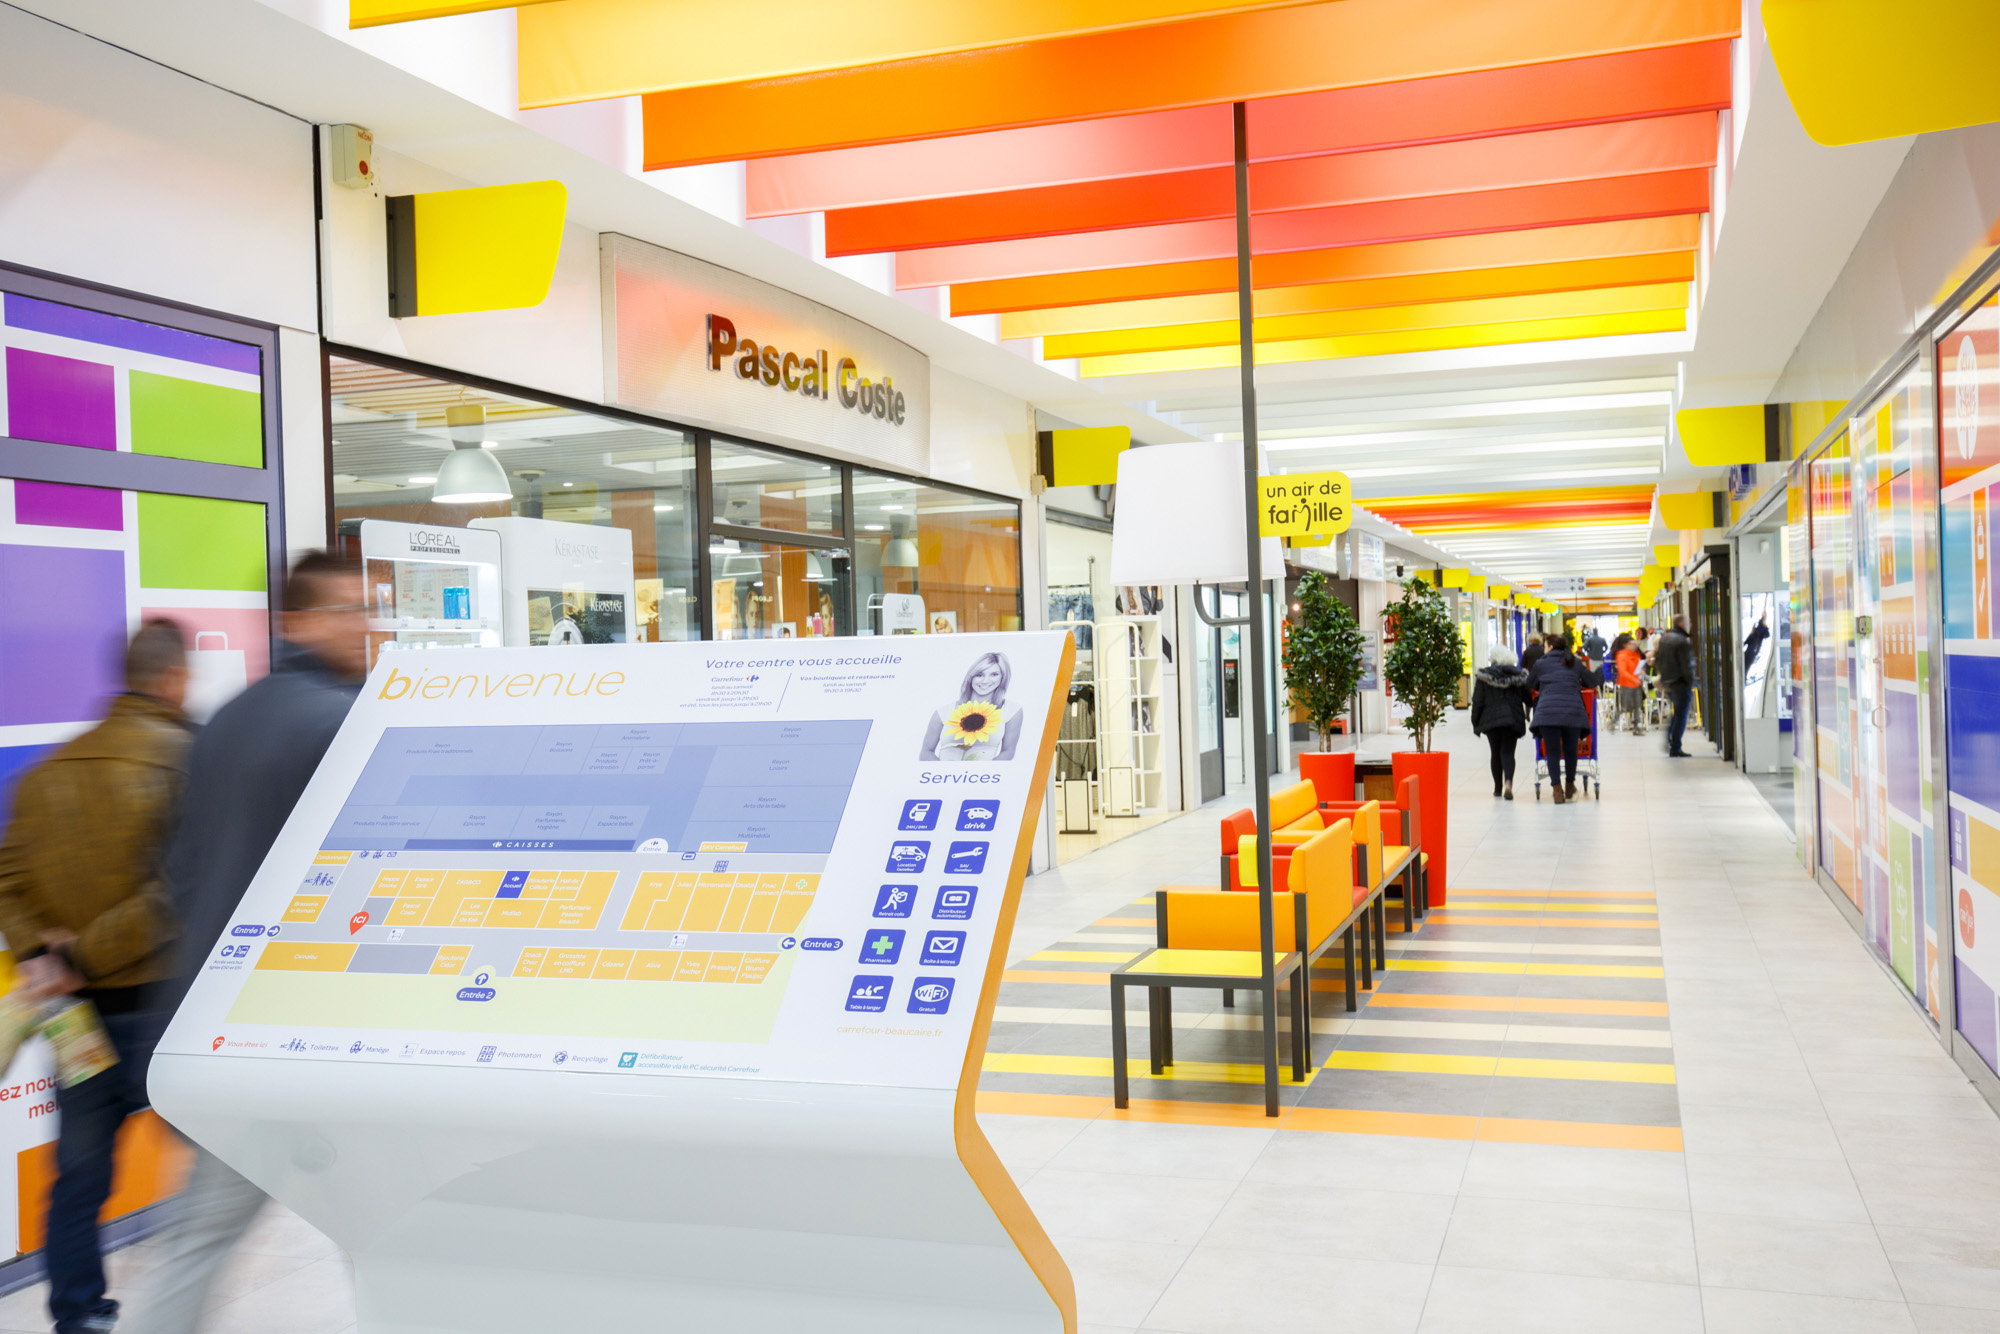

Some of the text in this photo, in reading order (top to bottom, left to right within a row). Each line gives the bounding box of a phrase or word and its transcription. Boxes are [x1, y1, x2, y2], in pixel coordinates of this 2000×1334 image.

[706, 314, 905, 426] Pascal Coste
[1266, 480, 1342, 498] un air de
[590, 597, 623, 612] KÉRASTASE
[706, 654, 901, 669] Votre centre vous accueille
[377, 667, 626, 701] bienvenue
[919, 771, 1001, 784] Services
[963, 822, 986, 830] drive
[506, 841, 555, 849] CAISSES
[352, 915, 367, 924] ICI
[234, 926, 258, 935] Entrée
[803, 940, 841, 949] Entrée 3
[744, 956, 771, 965] Coiffure
[679, 967, 702, 975] Rocher
[459, 991, 493, 999] Entrée 2
[917, 988, 945, 999] WiFi
[836, 1025, 944, 1037] carrefour-beaucaire.fr
[227, 1040, 269, 1048] Vous êtes ici
[309, 1043, 339, 1052] Toilettes
[365, 1046, 390, 1055] Manège
[419, 1048, 466, 1058] Espace repos
[498, 1051, 542, 1060] Photomaton
[571, 1055, 609, 1064] Recyclage
[640, 1053, 684, 1061] Défibrillateur
[637, 1061, 671, 1069] accessible
[699, 1063, 726, 1071] sécurité
[727, 1065, 760, 1073] Carrefour
